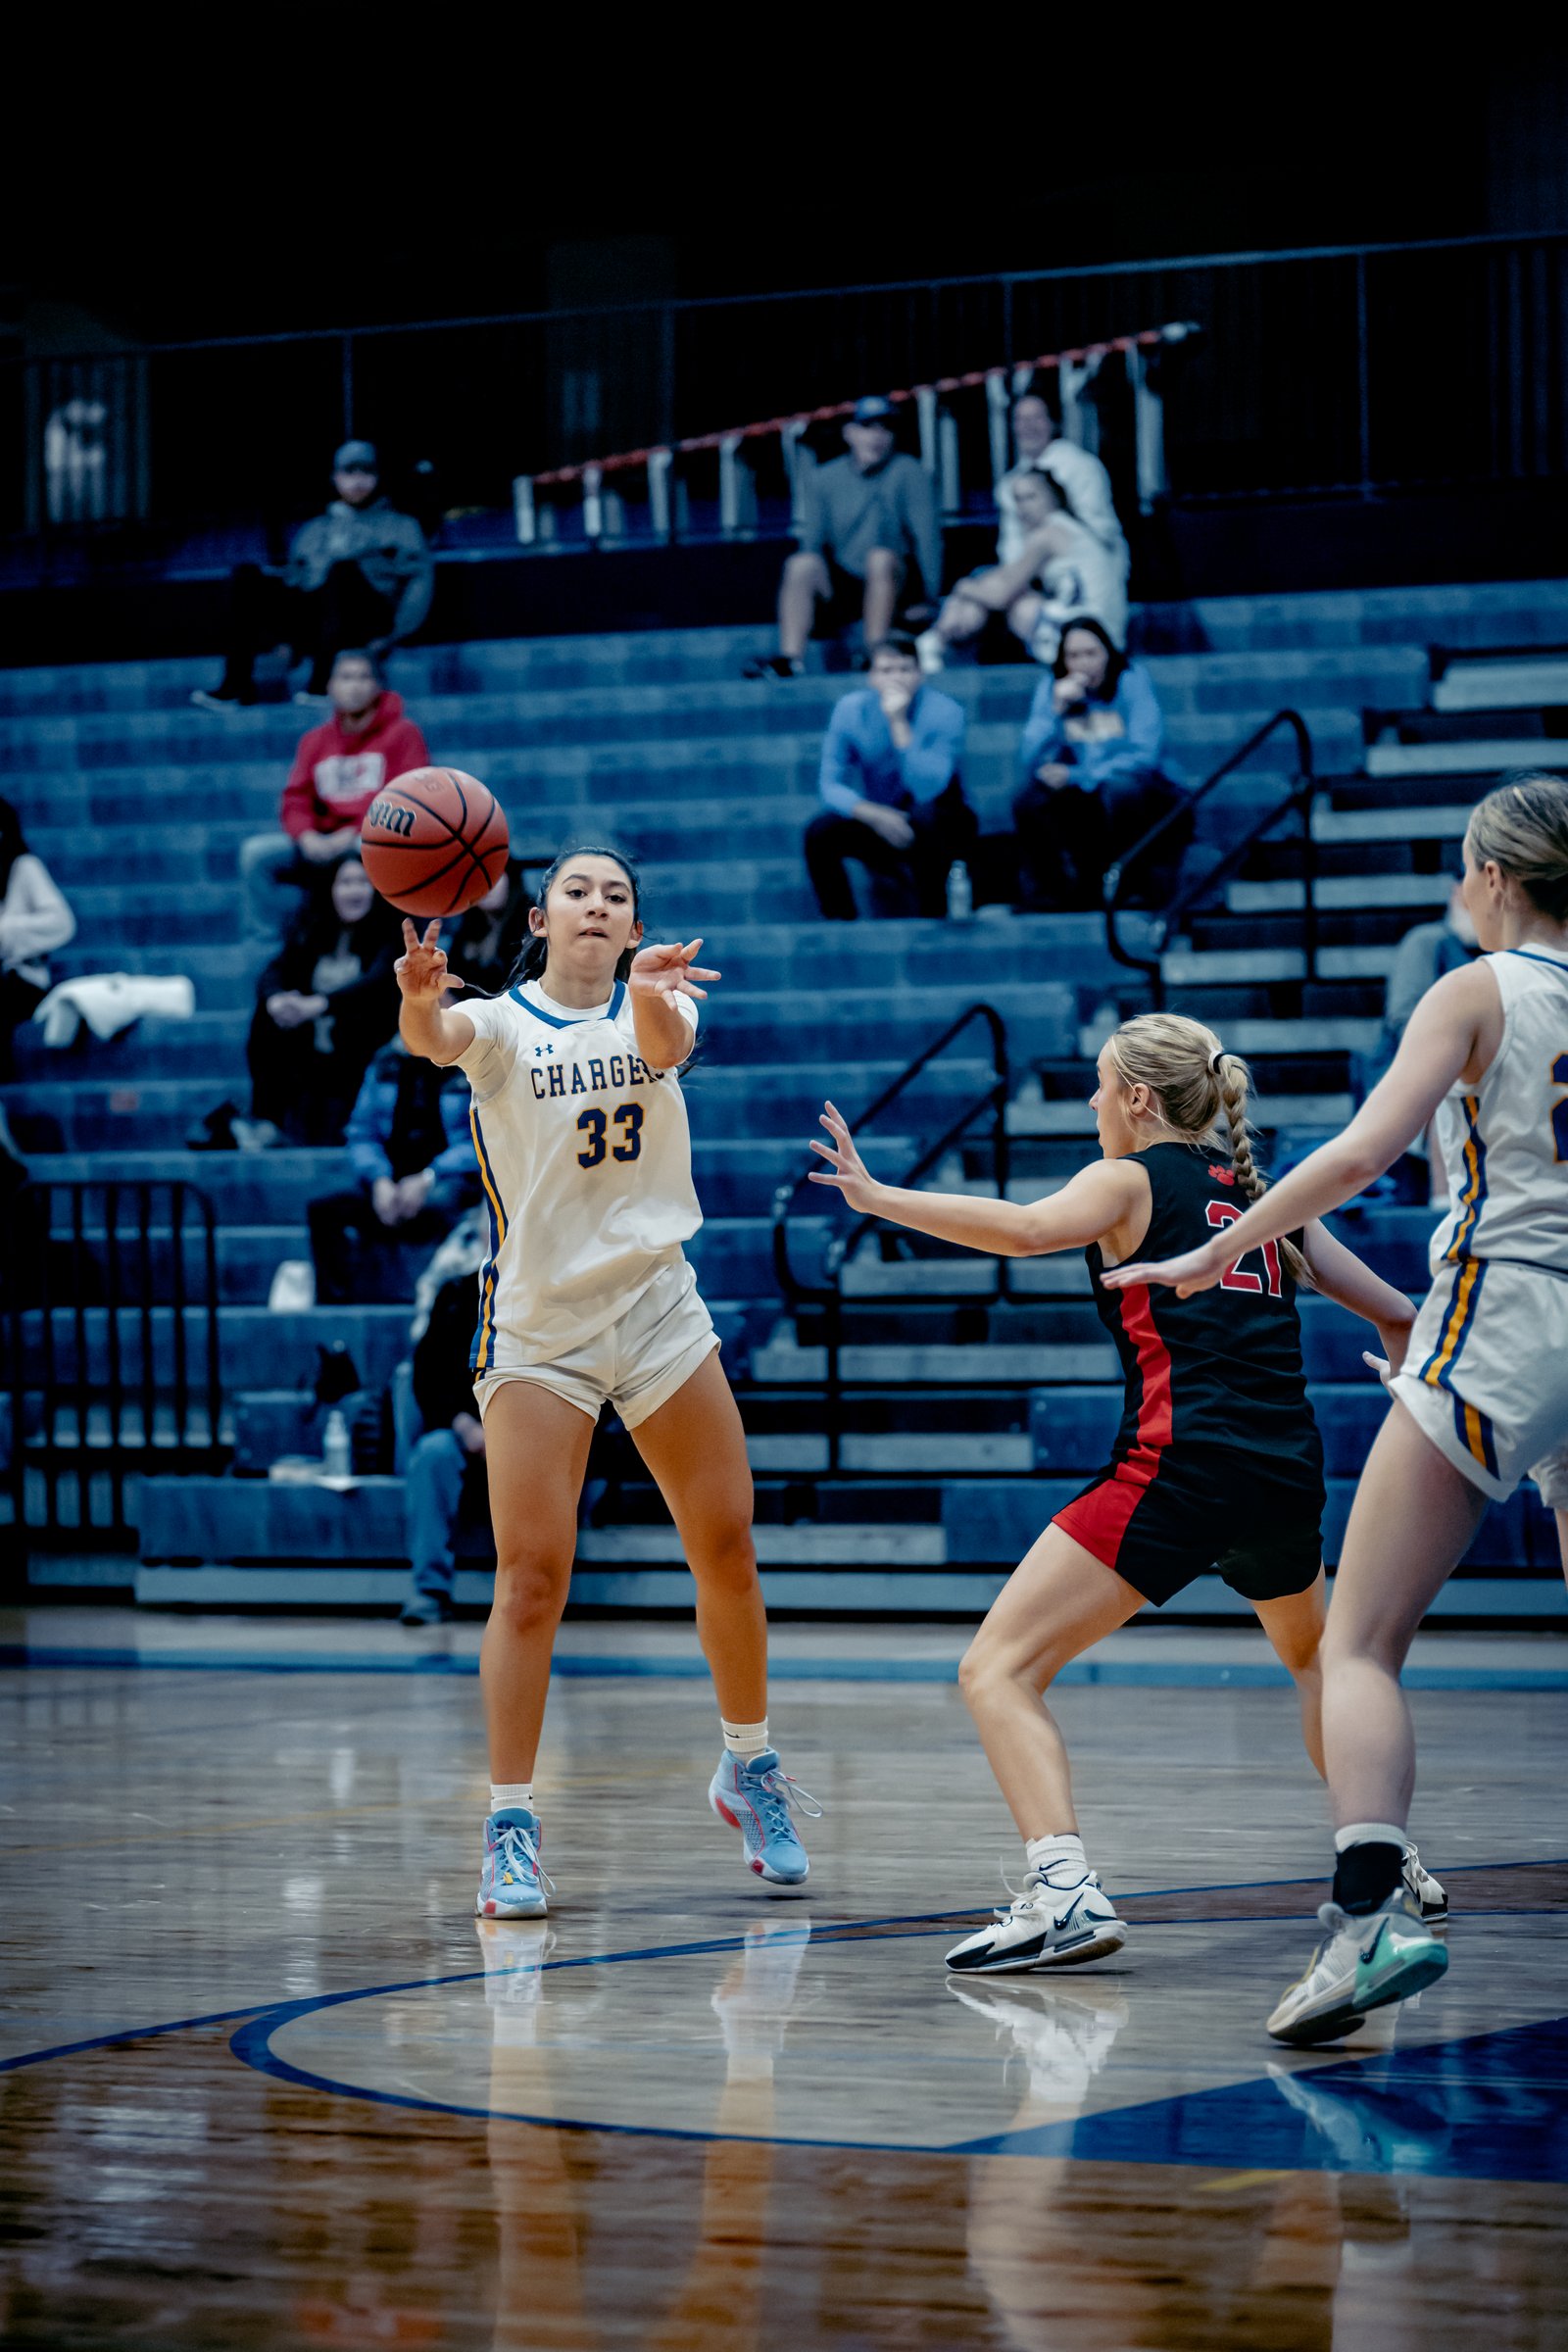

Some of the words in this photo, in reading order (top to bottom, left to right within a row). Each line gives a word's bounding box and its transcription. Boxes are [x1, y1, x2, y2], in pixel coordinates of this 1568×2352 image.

[530, 1054, 665, 1100] CHARGE
[576, 1102, 644, 1169] 33
[1204, 1200, 1283, 1298] 21
